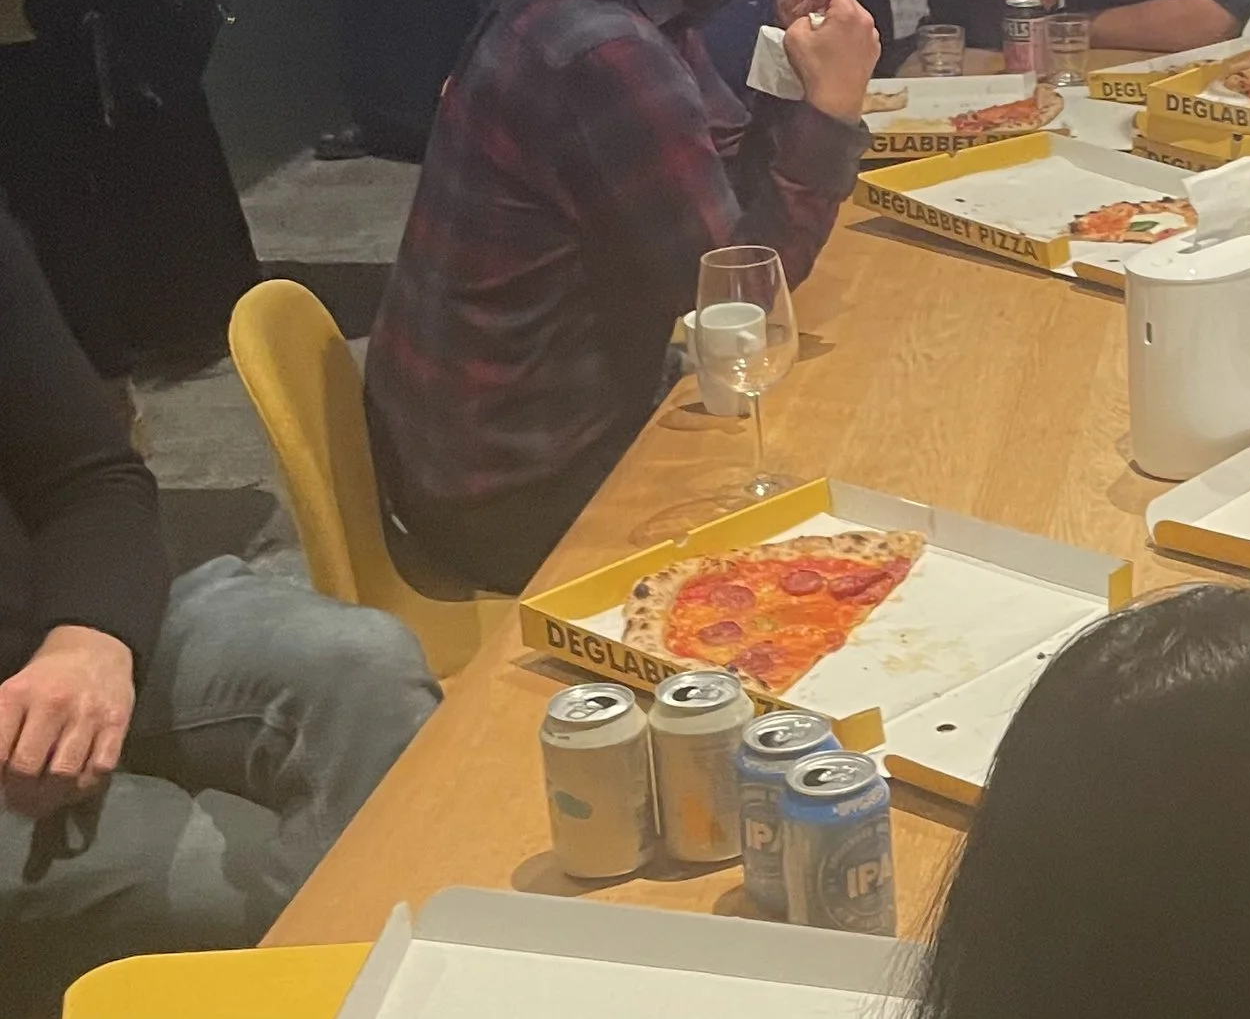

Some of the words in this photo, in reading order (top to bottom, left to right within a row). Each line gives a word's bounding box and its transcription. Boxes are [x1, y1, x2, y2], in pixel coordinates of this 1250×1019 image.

[1102, 81, 1148, 97] DEGL
[870, 135, 978, 153] GLABBET
[867, 185, 973, 238] DEGLABBET
[979, 228, 1038, 261] PIZZA
